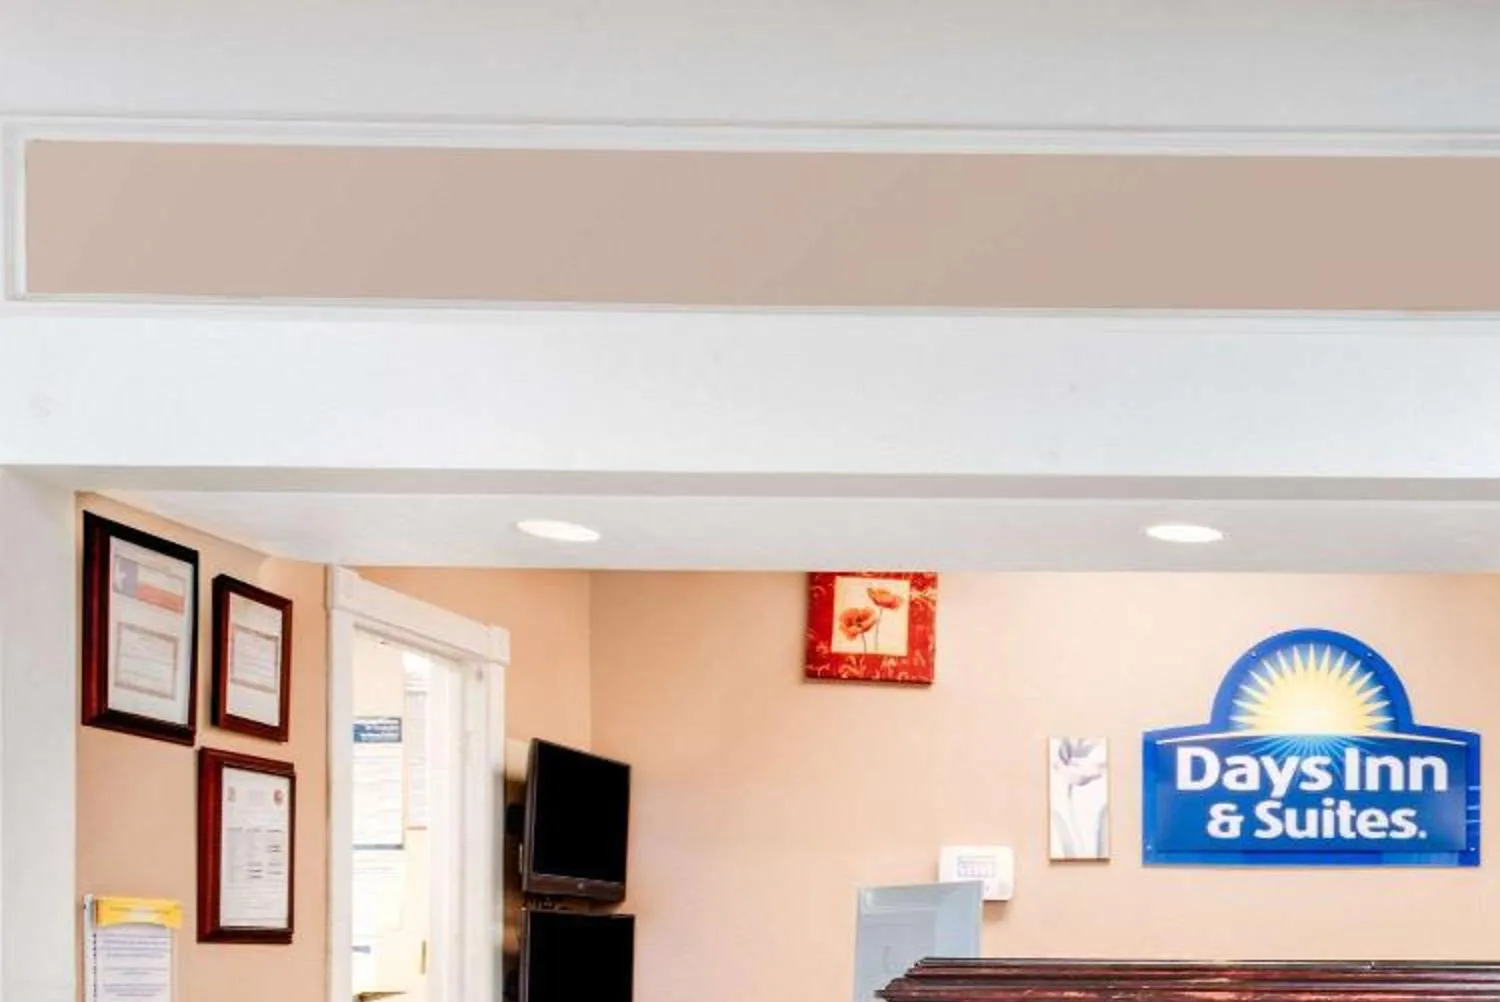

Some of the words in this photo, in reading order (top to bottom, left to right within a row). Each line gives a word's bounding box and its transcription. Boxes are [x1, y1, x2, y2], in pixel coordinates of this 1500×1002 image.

[1176, 746, 1332, 799] Days
[1344, 746, 1449, 792] Inn
[1207, 802, 1245, 840] &
